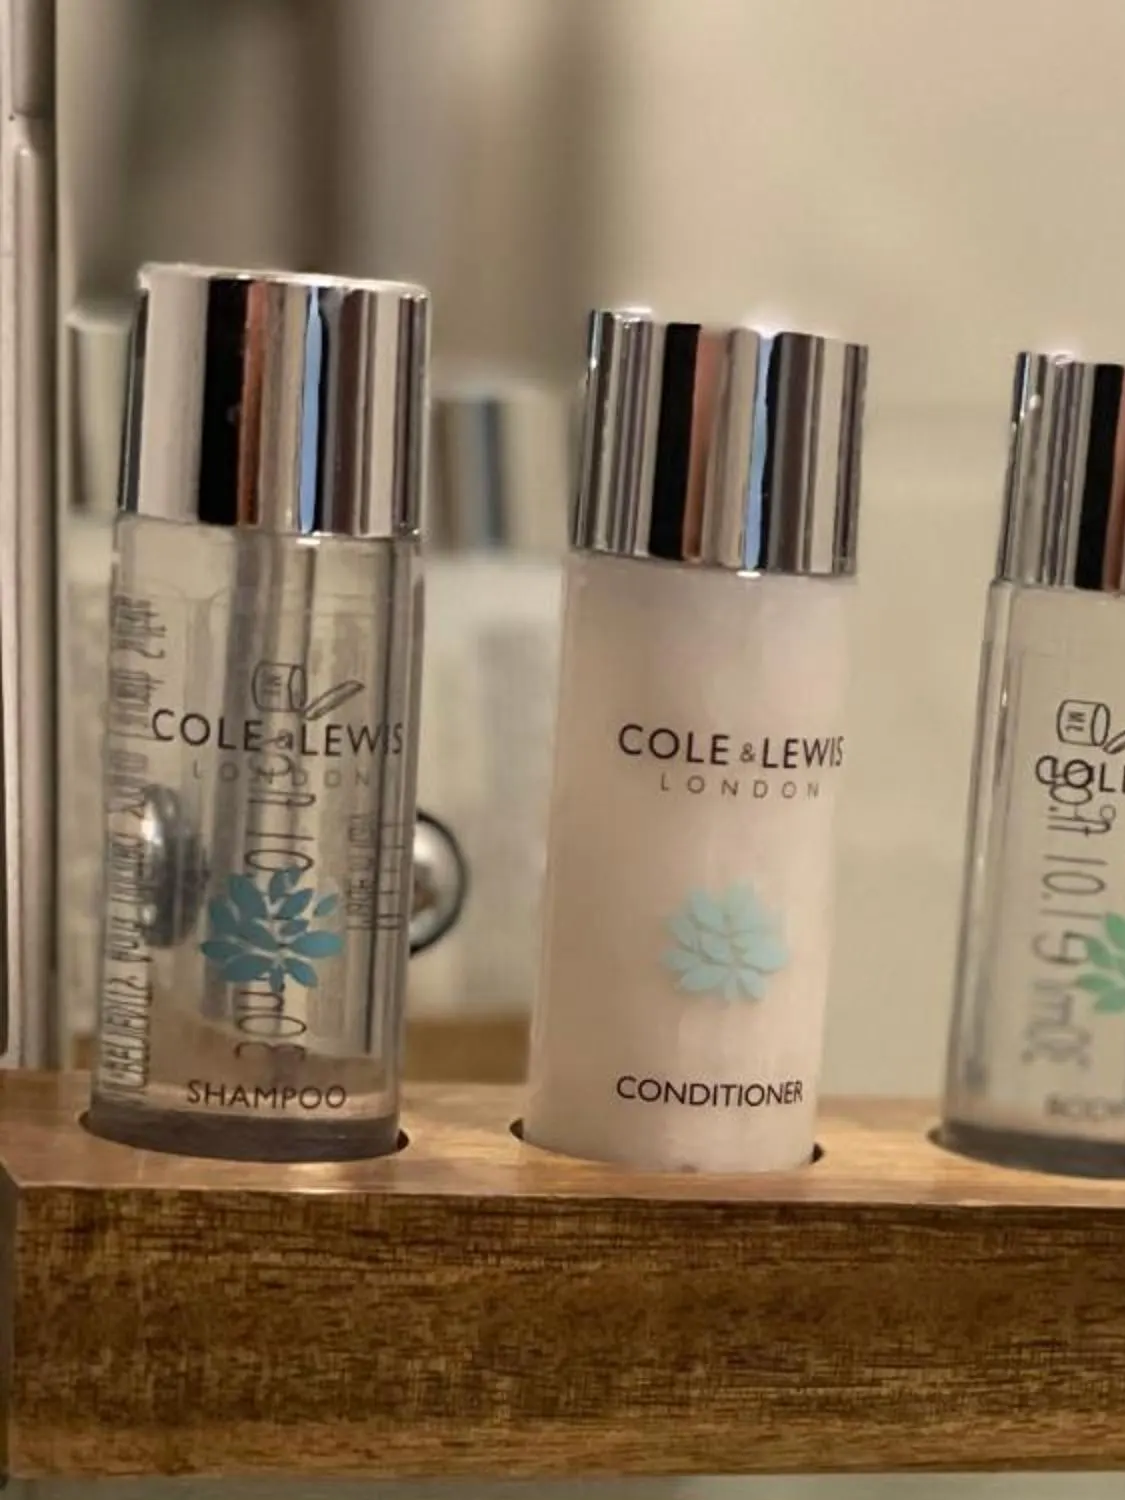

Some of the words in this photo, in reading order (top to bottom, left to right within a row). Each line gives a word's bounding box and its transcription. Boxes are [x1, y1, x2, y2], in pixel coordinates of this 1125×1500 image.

[151, 708, 263, 751] COLE
[300, 721, 403, 756] LEWIS
[617, 723, 730, 766] COLE
[761, 736, 845, 769] LEWIS
[660, 772, 820, 800] LONDON
[185, 1079, 347, 1111] SHAMPOO
[616, 1075, 803, 1108] CONDITIONER
